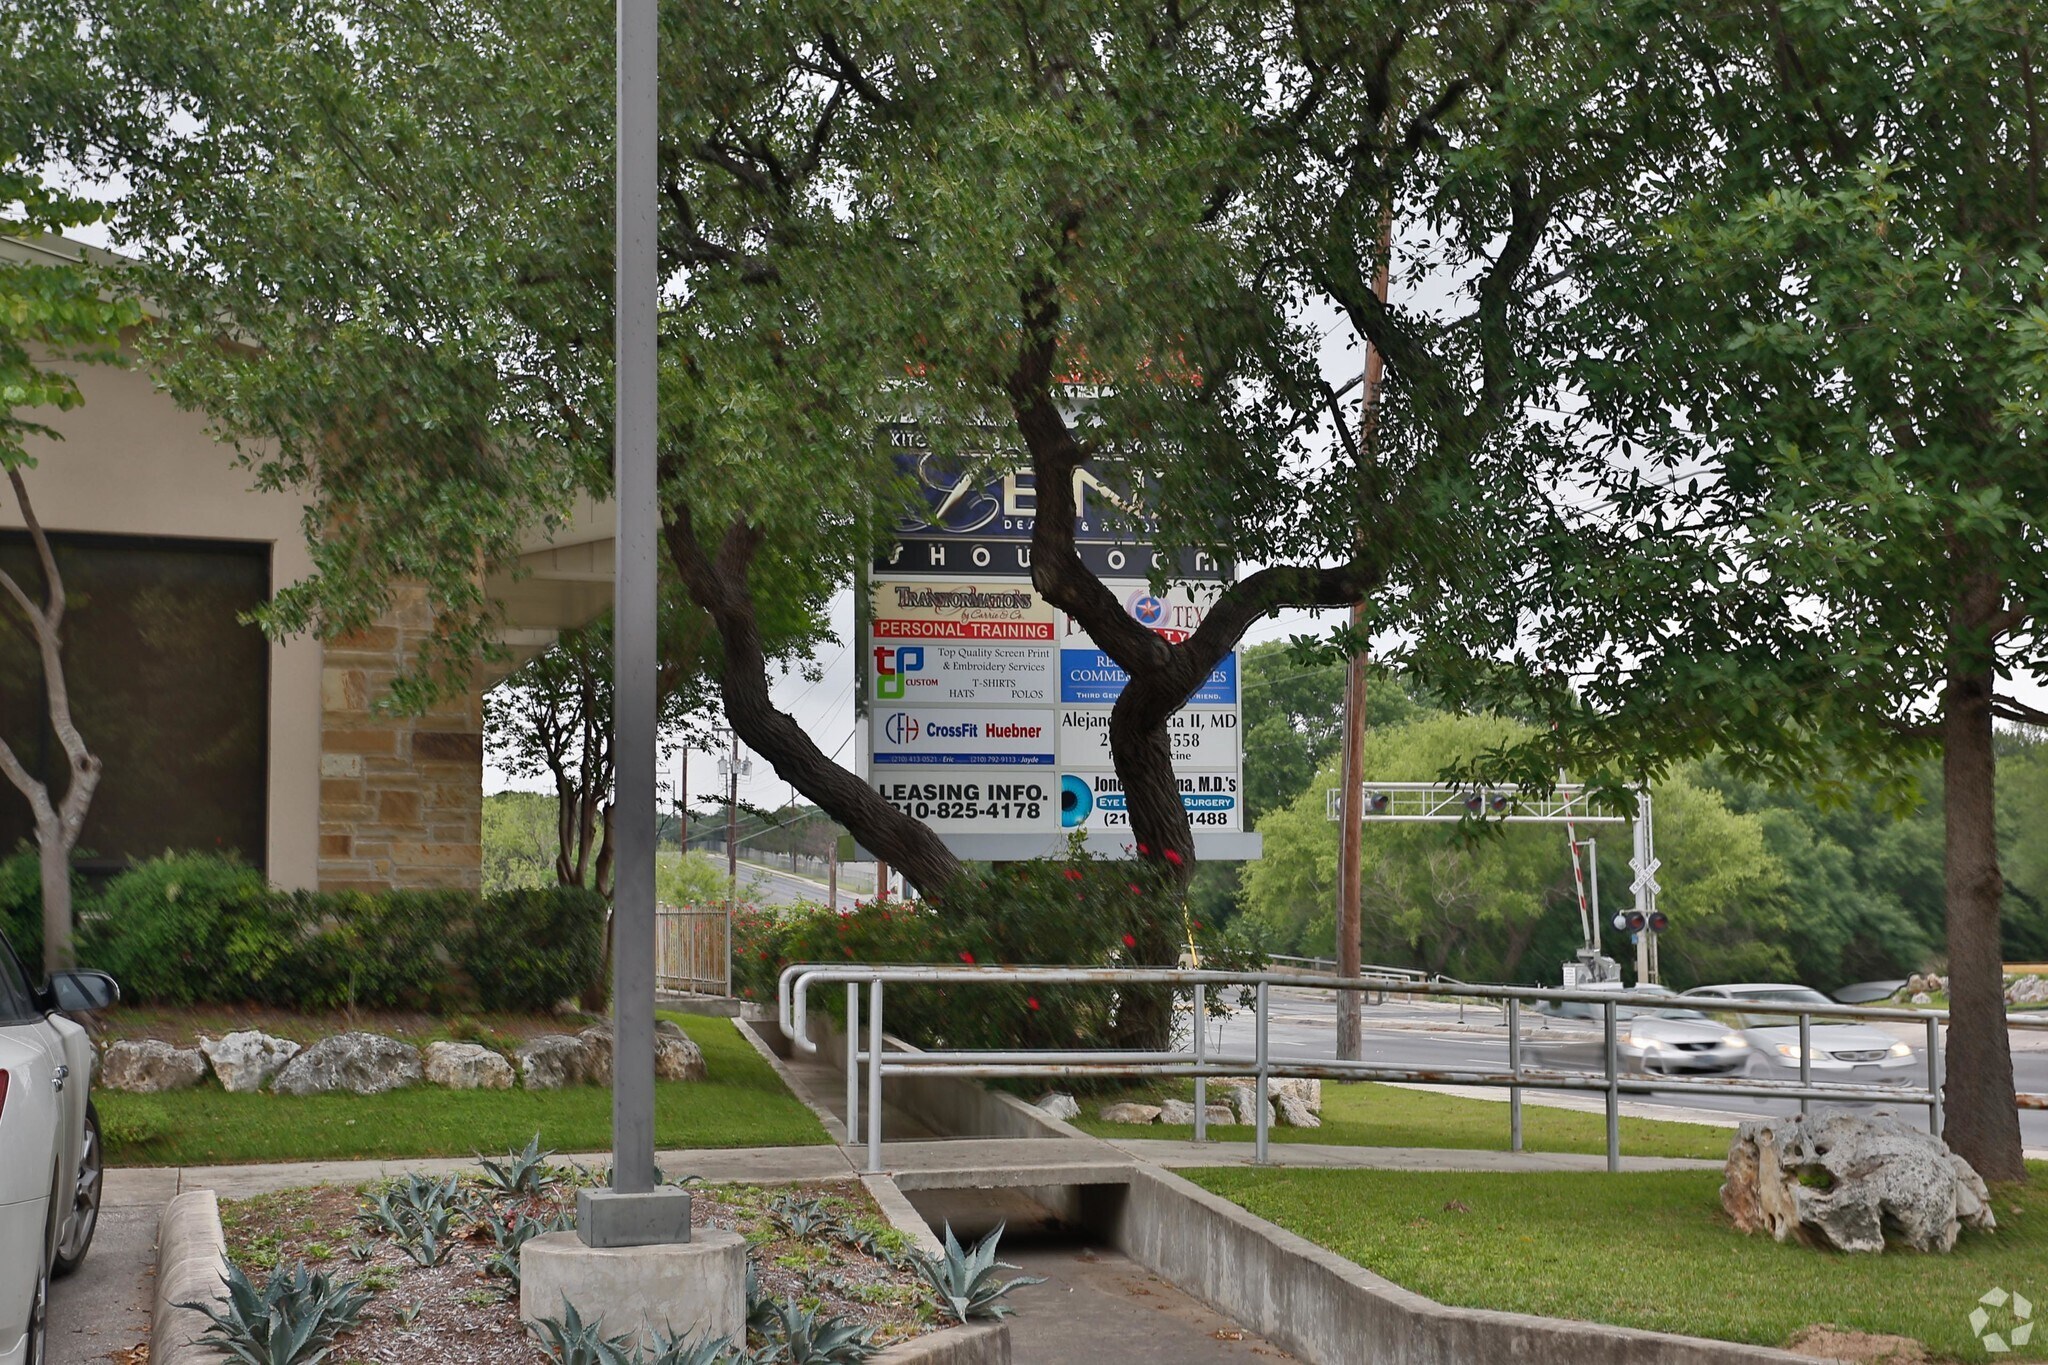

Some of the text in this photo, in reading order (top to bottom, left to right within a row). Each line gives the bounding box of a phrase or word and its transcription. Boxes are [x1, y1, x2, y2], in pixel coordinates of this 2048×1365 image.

[888, 544, 1219, 572] SHOWOOM
[1009, 609, 1025, 620] Co.
[1172, 605, 1203, 629] TEX
[880, 621, 965, 637] PERSONAL
[971, 623, 1048, 638] TRAINING
[938, 647, 1050, 660] Top Quality Screen Print
[943, 661, 1046, 673] & Embroidery Services
[905, 678, 939, 687] CUSTOM
[972, 678, 1016, 688] T-SHIRTS
[949, 689, 975, 699] HATS
[1011, 690, 1044, 700] POLOS
[1076, 691, 1101, 700] THIRD
[1193, 693, 1222, 701] RIEND.
[1210, 714, 1237, 728] MD
[926, 722, 1042, 739] CrossFit Huebner
[970, 756, 987, 764] (210)
[1020, 757, 1039, 765] Jayde
[1094, 776, 1124, 792] Jone
[879, 784, 1048, 801] LEASING INFO.
[1099, 799, 1119, 807] EYE
[1184, 798, 1231, 807] SURGERY
[1104, 812, 1126, 827] (21
[1632, 860, 1659, 890] CROSSING
